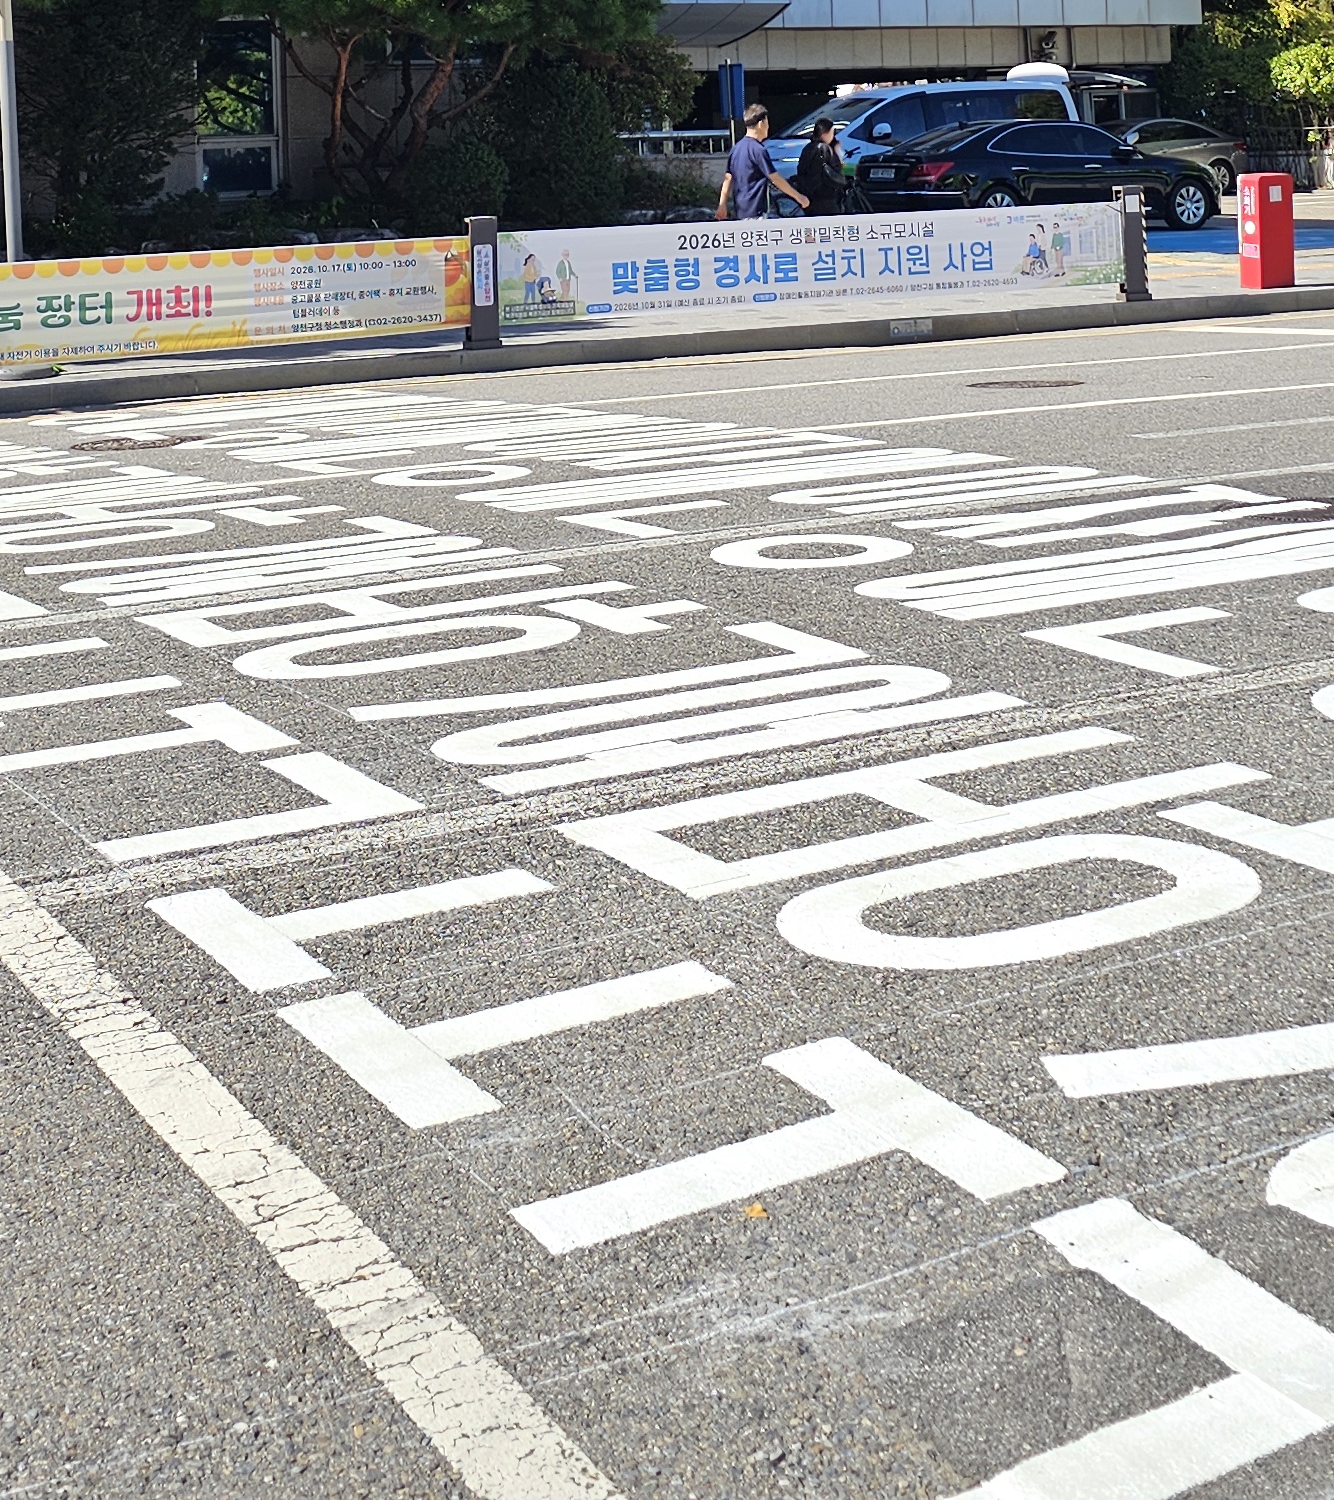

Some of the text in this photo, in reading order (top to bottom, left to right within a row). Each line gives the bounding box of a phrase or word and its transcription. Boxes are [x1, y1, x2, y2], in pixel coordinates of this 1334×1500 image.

[677, 221, 935, 251] 2026년 양천구 생활밀착형 소규모시설
[359, 261, 383, 270] 10:00
[393, 259, 417, 268] 13:00
[611, 240, 994, 295] 맞춤형 경사로 설치 지원 사업
[36, 291, 113, 329] 장터
[125, 284, 213, 323] 개최!
[614, 303, 639, 312] 2026년
[641, 301, 656, 310] 10월
[7, 349, 32, 361] 자전거
[34, 347, 59, 358] 이용을
[62, 345, 95, 357] 자제하여
[97, 343, 122, 354] 주시기
[123, 341, 159, 352] 바랍니다.
